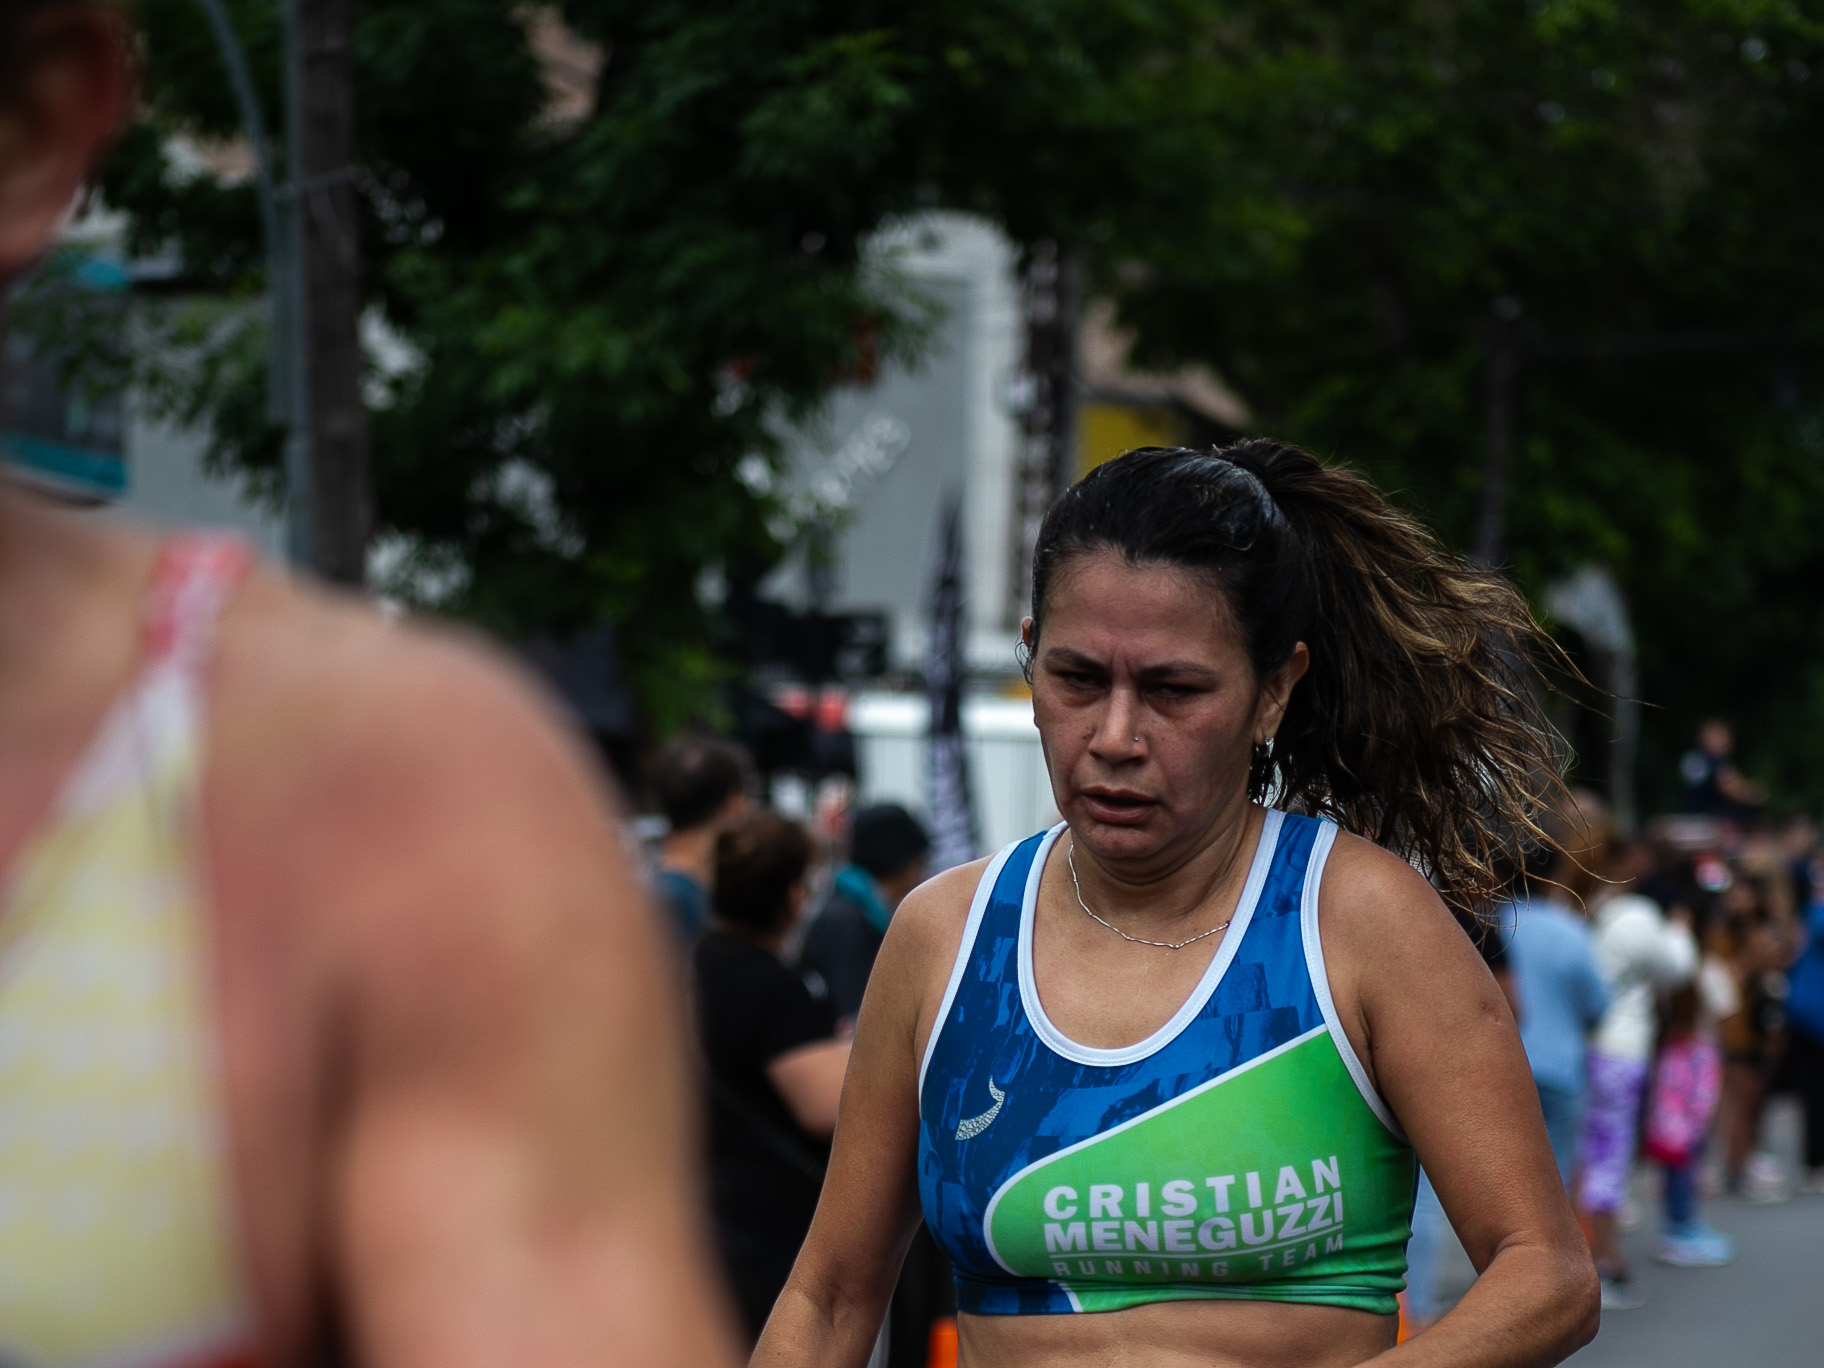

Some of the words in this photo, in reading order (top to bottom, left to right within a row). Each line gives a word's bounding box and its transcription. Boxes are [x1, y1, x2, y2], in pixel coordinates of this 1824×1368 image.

[1046, 1156, 1341, 1219] CRISTIAN
[1044, 1191, 1344, 1253] MENEGUZZI
[1053, 1258, 1229, 1278] RUNNING
[1259, 1234, 1344, 1272] TEAM
